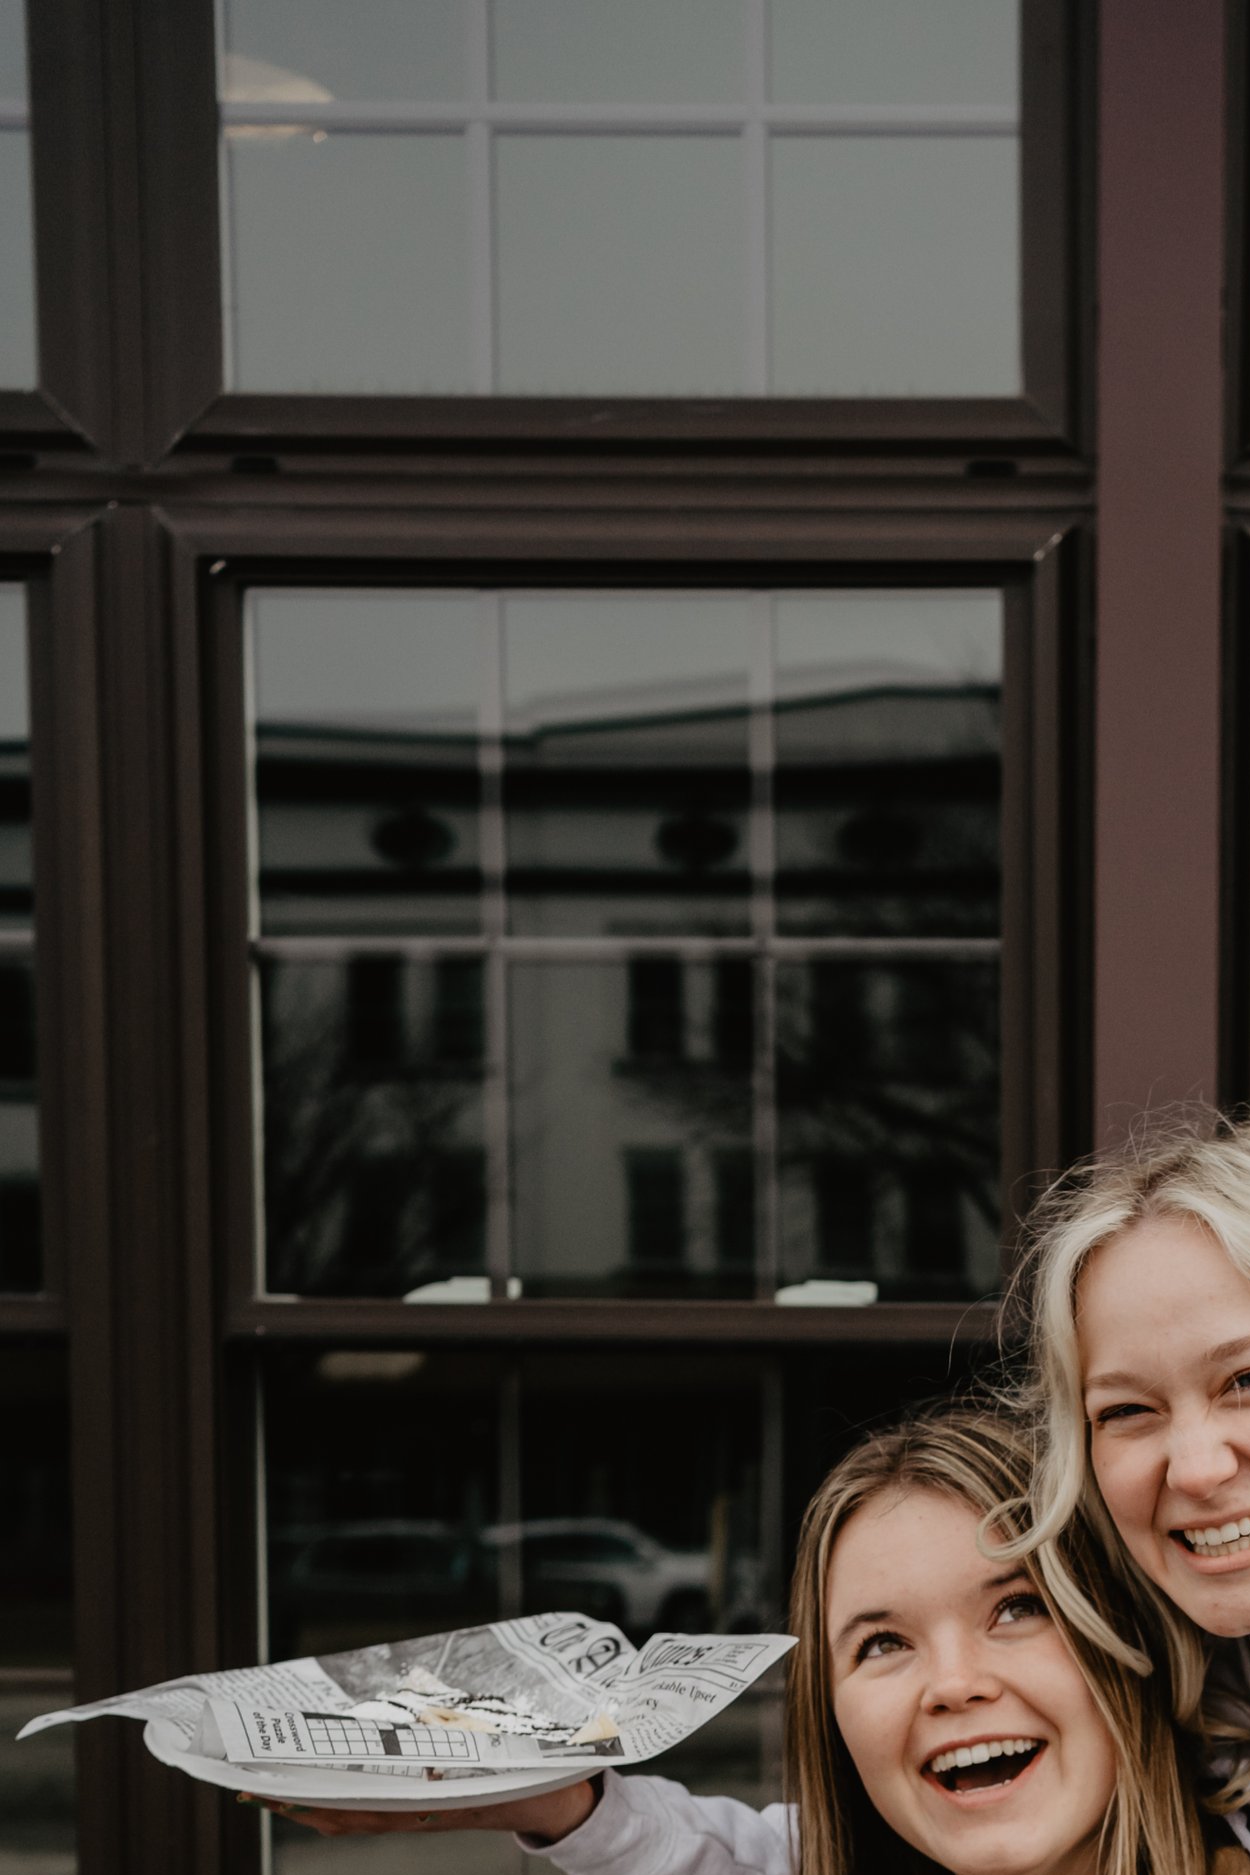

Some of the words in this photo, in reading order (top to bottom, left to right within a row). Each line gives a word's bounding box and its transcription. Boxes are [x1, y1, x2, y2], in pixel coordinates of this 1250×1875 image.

[253, 1712, 264, 1720] of
[256, 1720, 267, 1733] the
[271, 1718, 286, 1743] Puzzle
[284, 1712, 306, 1752] Crossword
[260, 1735, 272, 1752] Day
